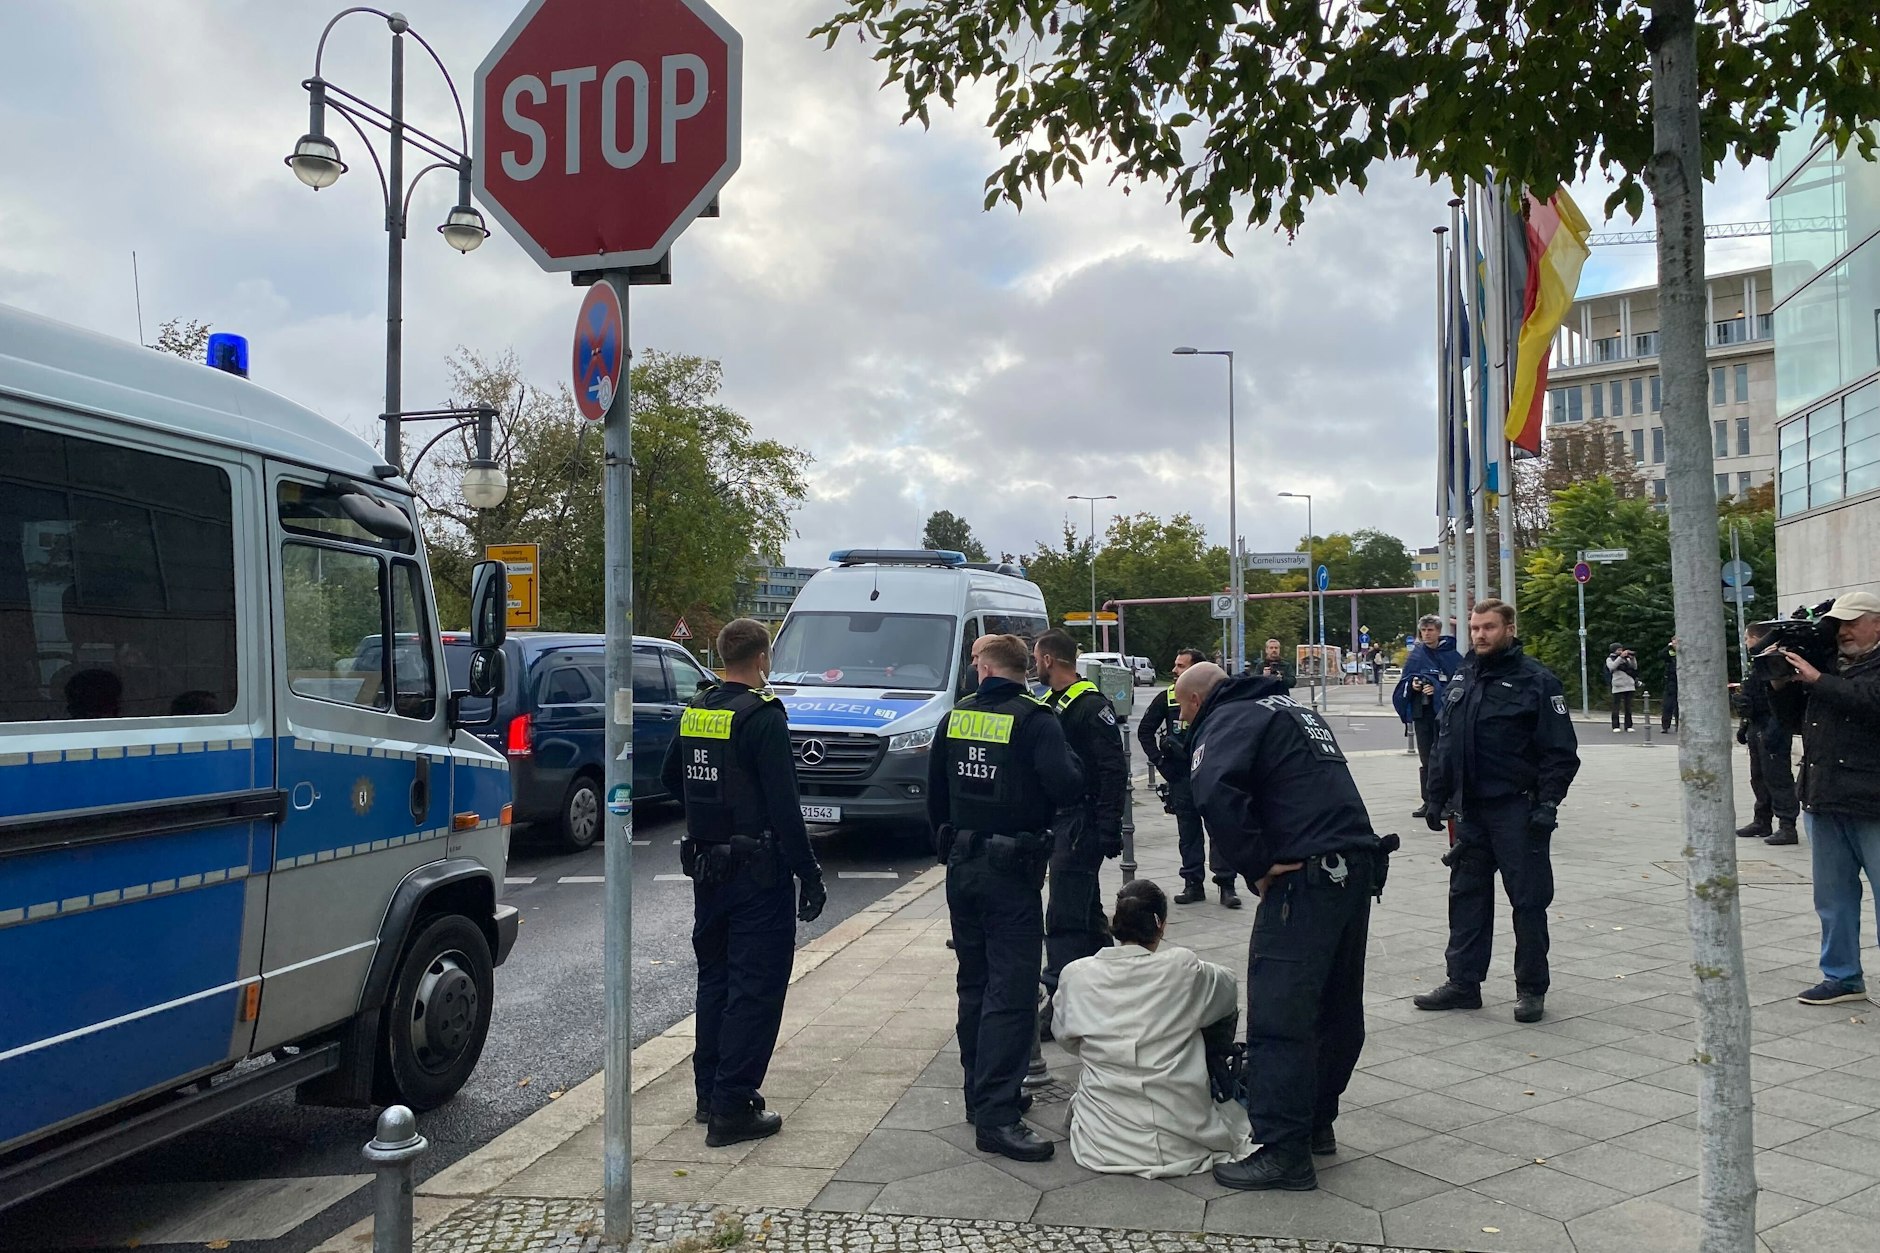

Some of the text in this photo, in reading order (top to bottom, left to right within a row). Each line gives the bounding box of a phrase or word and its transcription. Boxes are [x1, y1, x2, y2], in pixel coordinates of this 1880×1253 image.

[501, 53, 709, 182] STOP
[784, 702, 871, 715] POLIZEI
[681, 711, 731, 735] POLIZEI
[949, 712, 1012, 742] POLIZEI
[1301, 713, 1319, 726] BE
[1304, 726, 1334, 742] 31320
[694, 749, 708, 764] BE
[968, 746, 986, 762] BE
[687, 765, 718, 781] 31218
[957, 761, 997, 779] 31137
[802, 806, 833, 818] 31543
